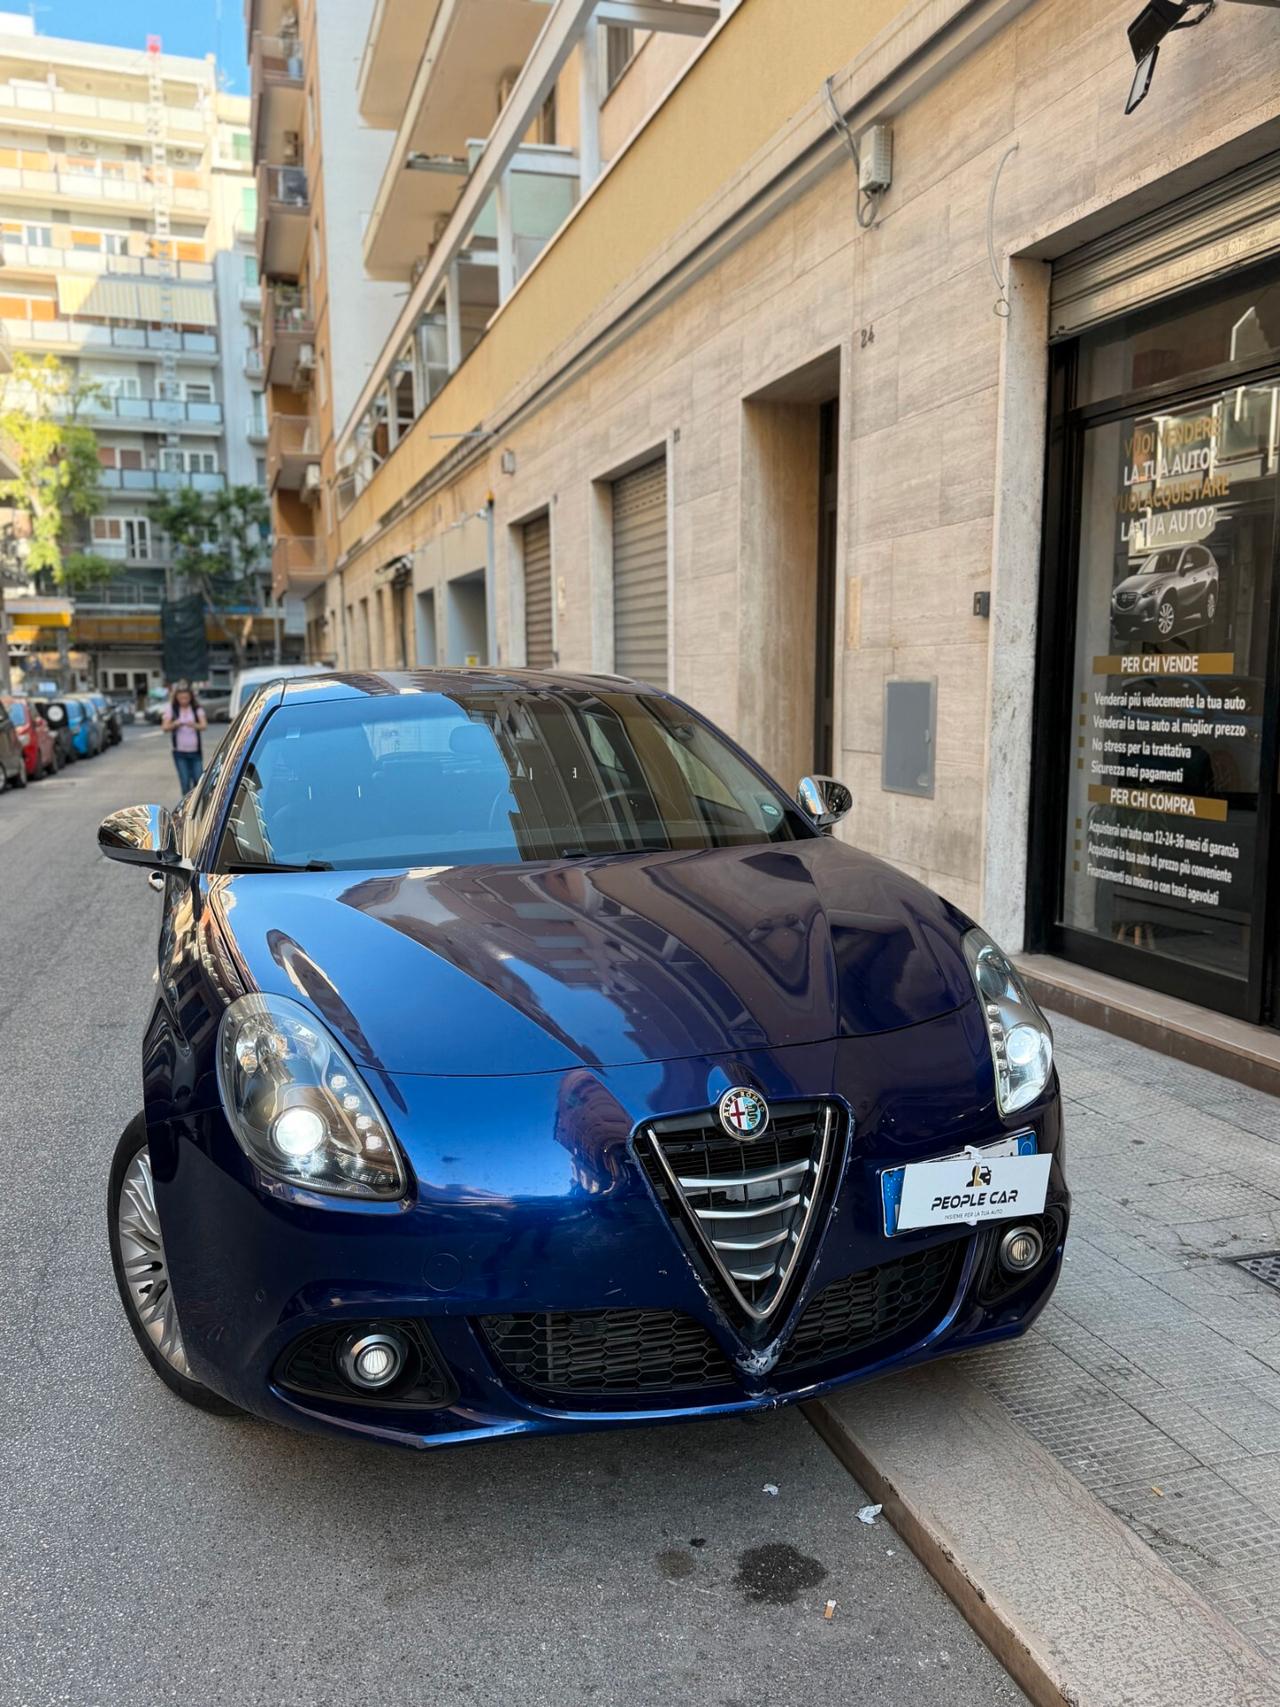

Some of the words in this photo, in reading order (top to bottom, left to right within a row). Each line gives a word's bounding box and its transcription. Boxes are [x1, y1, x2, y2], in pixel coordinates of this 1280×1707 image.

[861, 324, 876, 348] 24
[1124, 464, 1139, 486] LA
[1143, 457, 1169, 480] TUA
[1121, 518, 1137, 541] LA
[1169, 507, 1214, 533] AUTO?
[1121, 656, 1140, 673] PER
[1142, 655, 1160, 673] CHI
[1162, 655, 1199, 673] VENDE
[1094, 691, 1128, 706] Venderai
[1143, 692, 1195, 708] velocemente
[1196, 693, 1205, 709] la
[1207, 695, 1222, 710] tua
[1224, 695, 1246, 710] auto
[1093, 715, 1126, 730] Venderai
[1127, 716, 1135, 730] la
[1136, 717, 1150, 731] tua
[1151, 718, 1170, 732] auto
[1171, 718, 1180, 733] al
[1181, 718, 1214, 737] miglior
[1214, 723, 1246, 739] prezzo
[1092, 737, 1102, 752] No
[1103, 740, 1126, 753] stress
[1127, 743, 1141, 757] per
[1142, 741, 1150, 755] la
[1152, 742, 1191, 759] trattativa
[1091, 760, 1125, 776] Sicurezza
[1126, 763, 1139, 778] nei
[1139, 768, 1184, 783] pagamenti
[1110, 788, 1129, 806] PER
[1130, 791, 1148, 809] CHI
[1149, 793, 1196, 816] COMPRA
[1143, 831, 1154, 843] con
[1155, 830, 1185, 848] 12-24-36
[1184, 836, 1201, 852] mesi
[1201, 838, 1210, 853] di
[1209, 842, 1239, 859] garanzia
[1158, 858, 1179, 872] prezzo
[1191, 865, 1232, 884] conveniente
[1171, 882, 1187, 898] tassi
[1187, 888, 1219, 906] agevolati
[931, 1192, 987, 1211] PEOPLE
[989, 1189, 1018, 1204] CAR
